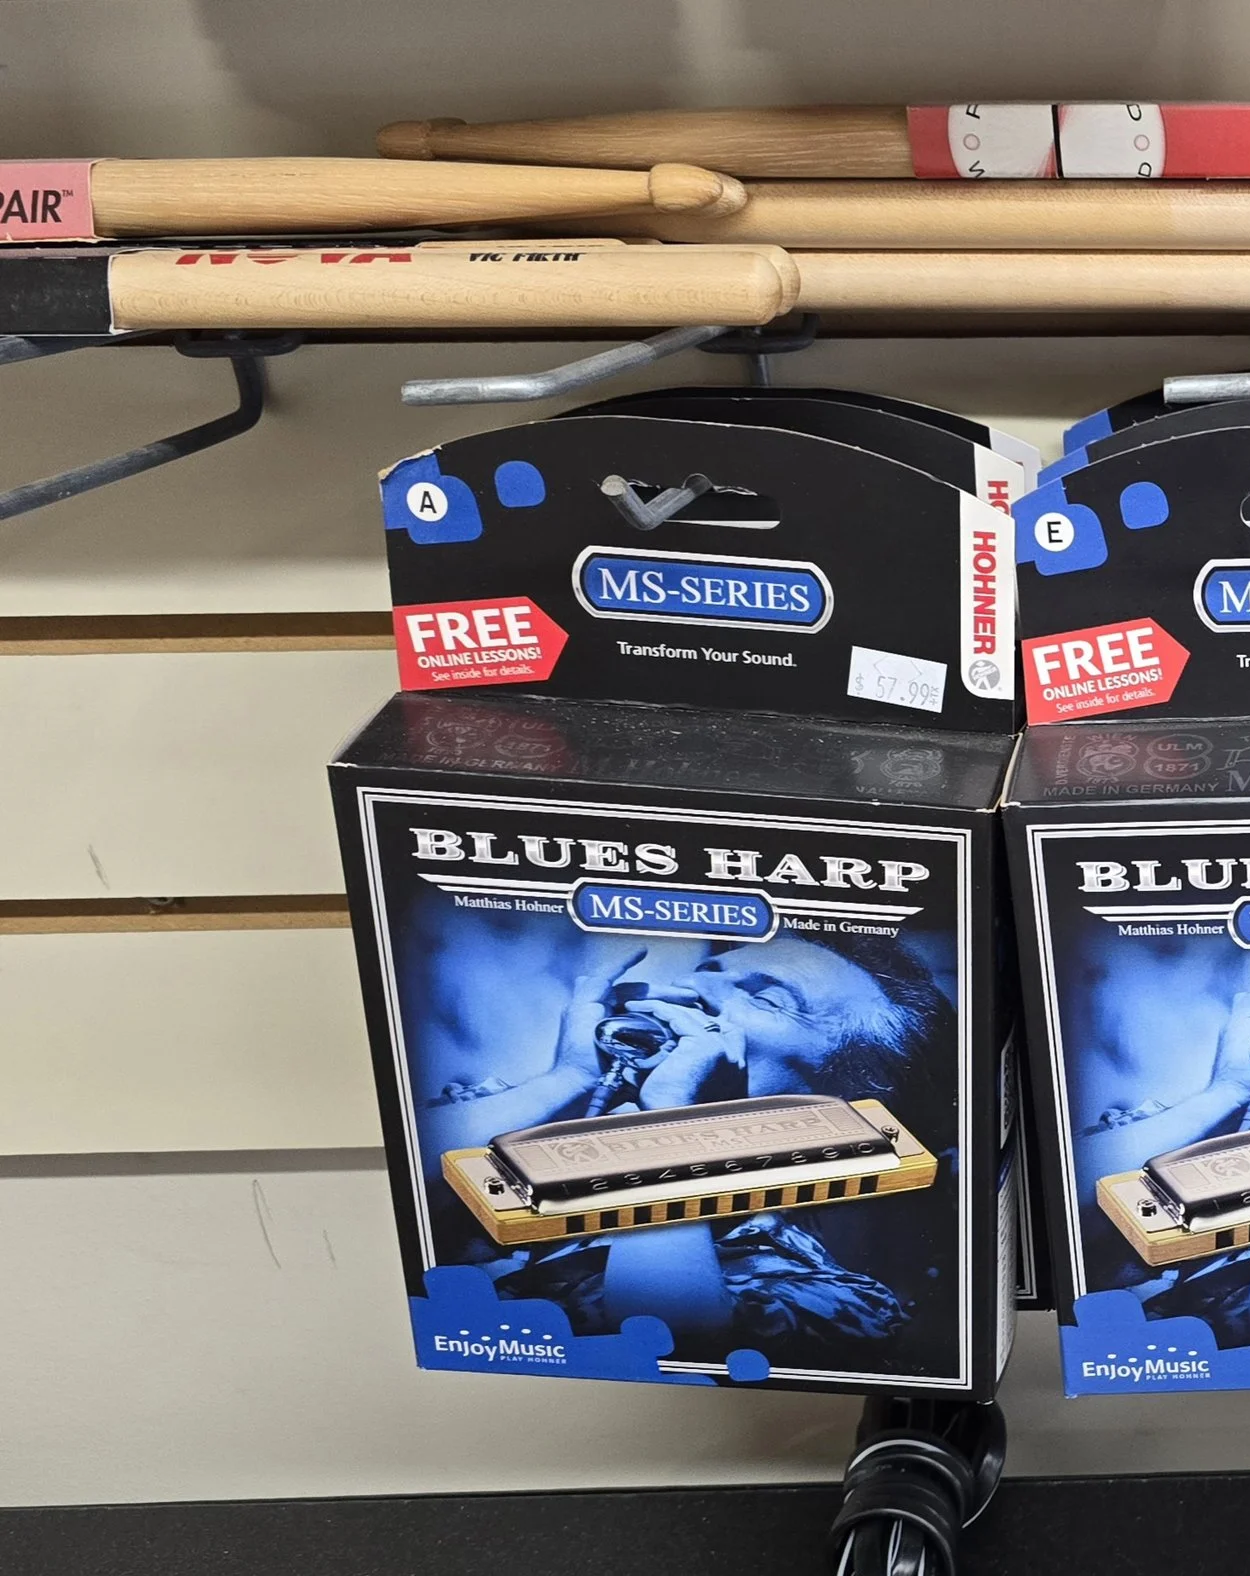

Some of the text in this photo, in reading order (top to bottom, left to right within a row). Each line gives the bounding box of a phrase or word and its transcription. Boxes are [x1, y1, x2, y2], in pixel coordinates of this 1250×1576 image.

[418, 490, 437, 514] A
[1046, 521, 1063, 544] E
[597, 566, 811, 613] MS-SERIES
[973, 531, 996, 655] HOHNER
[405, 605, 539, 652] FREE
[417, 647, 542, 669] ONLINE LESSONS!
[616, 641, 797, 667] Transform Your Sound.
[1032, 627, 1160, 685] FREE
[431, 670, 450, 682] See
[452, 667, 481, 680] inside
[482, 666, 498, 678] for
[1043, 668, 1163, 701] ONLINE LESSONS!
[875, 675, 930, 702] 57.99
[1056, 700, 1074, 714] See
[1076, 694, 1103, 710] inside
[1106, 691, 1119, 705] for
[1157, 742, 1204, 752] ULM
[1154, 763, 1200, 772] 1871
[1043, 781, 1220, 796] MADE IN GERMANY
[408, 827, 930, 893] BLUES HARP
[454, 893, 564, 915] Matthias Hohner
[589, 892, 759, 928] MS-SERIES
[783, 916, 900, 938] Made in Germany
[1118, 922, 1225, 937] Matthias Hohner
[624, 1173, 642, 1185] 3
[690, 1163, 708, 1176] 5
[724, 1159, 742, 1172] 6
[756, 1155, 773, 1168] 7
[821, 1147, 840, 1159] 9
